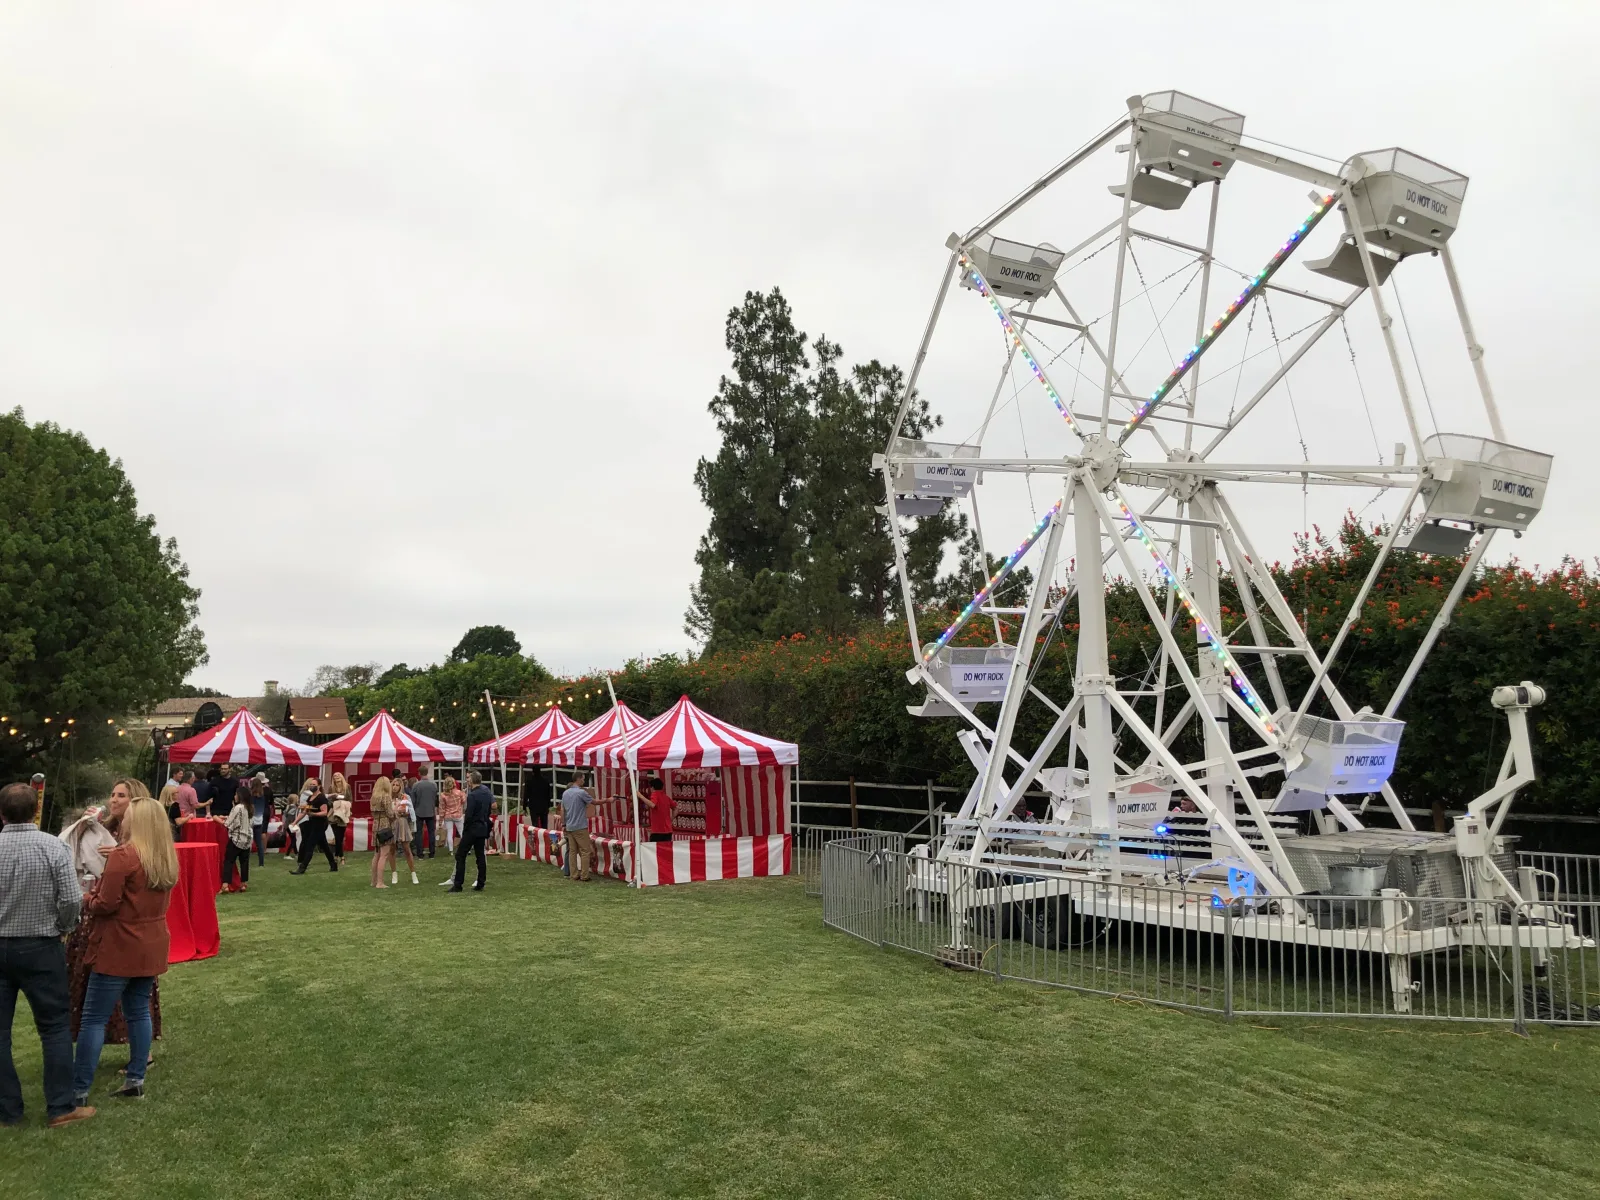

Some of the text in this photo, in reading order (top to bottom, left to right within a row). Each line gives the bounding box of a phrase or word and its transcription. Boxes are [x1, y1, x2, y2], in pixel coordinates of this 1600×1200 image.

[1406, 189, 1448, 216] DO NOT ROCK
[1000, 266, 1042, 282] DO NOT ROCK
[926, 466, 936, 474] DO
[936, 466, 949, 475] NOT
[1493, 479, 1534, 498] DO NOT ROCK
[963, 672, 1004, 681] DO NOT ROCK
[1344, 755, 1387, 766] DO NOT ROCK
[1117, 802, 1157, 813] DO NOT ROCK
